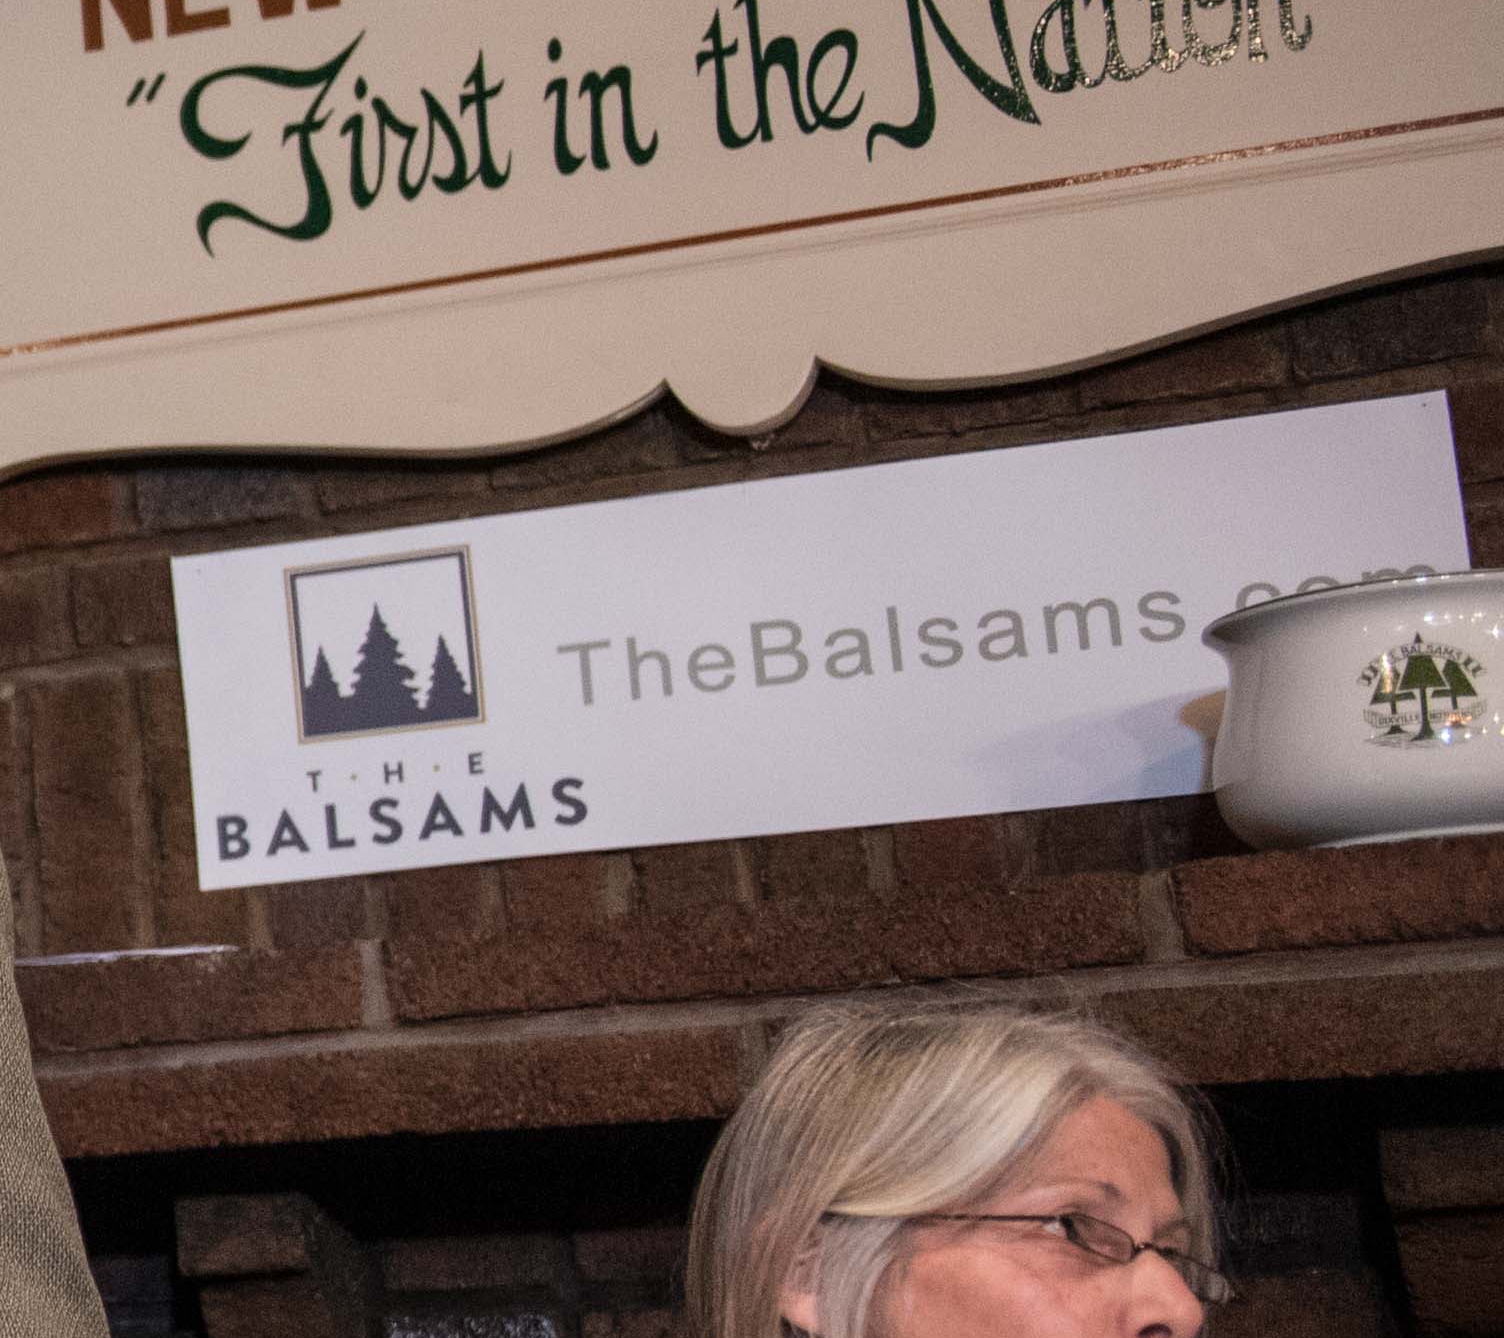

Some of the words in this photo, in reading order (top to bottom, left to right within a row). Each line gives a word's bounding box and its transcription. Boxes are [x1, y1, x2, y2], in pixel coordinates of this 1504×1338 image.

[545, 37, 659, 174] in
[557, 564, 1437, 707] TheBalsams
[216, 777, 589, 861] BALSAMS
